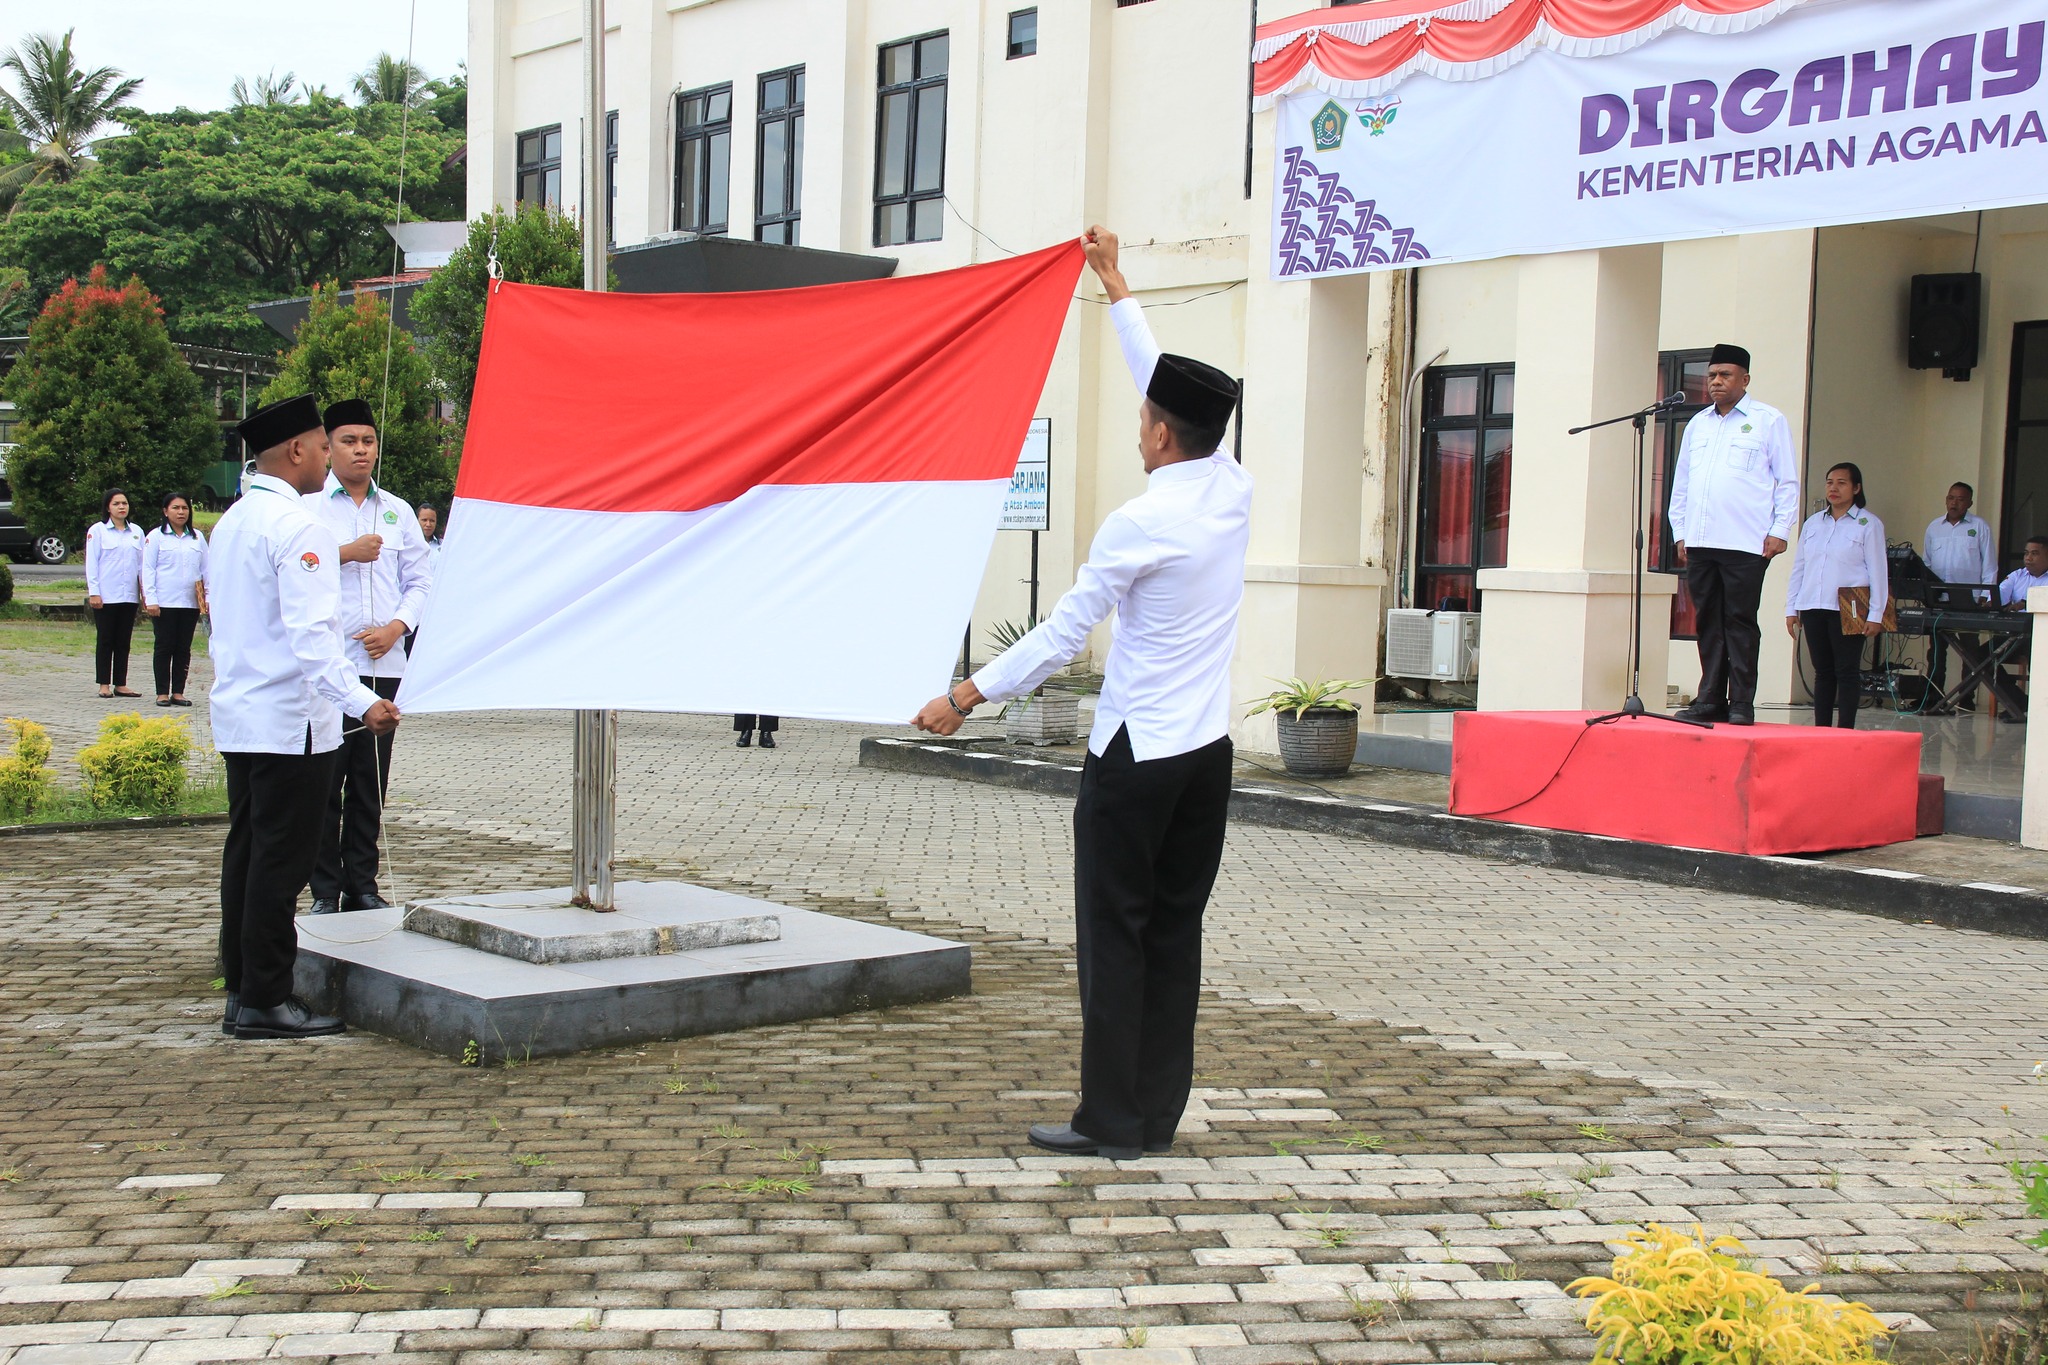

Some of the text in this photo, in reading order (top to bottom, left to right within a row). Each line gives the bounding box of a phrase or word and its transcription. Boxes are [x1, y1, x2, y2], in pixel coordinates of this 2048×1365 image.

[1579, 20, 2045, 155] DIRGAHAY
[1577, 110, 2048, 200] KEMENTERIAN AGAMA
[1009, 471, 1046, 494] SARJANA
[1024, 499, 1045, 510] Ambon
